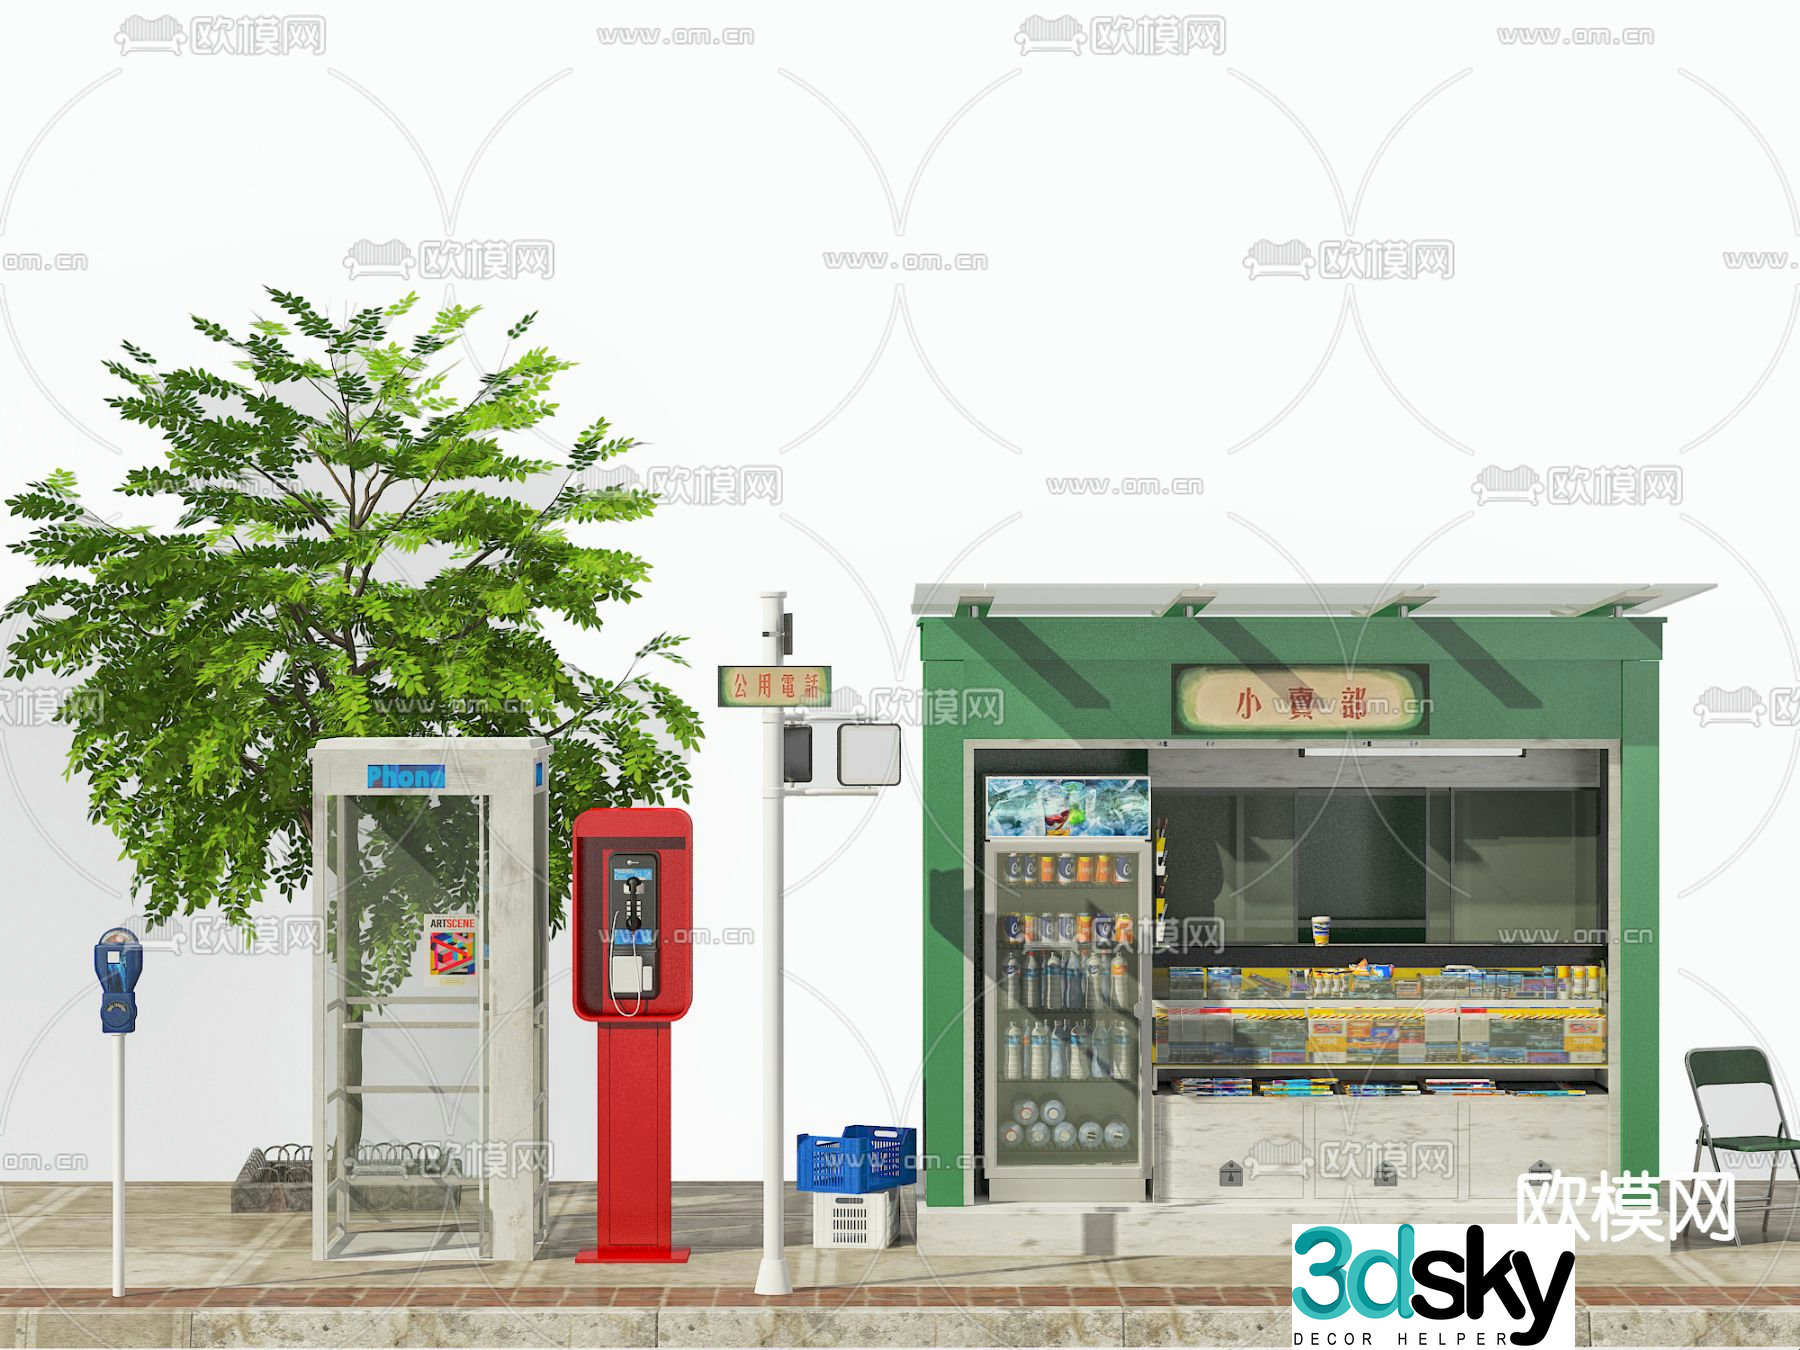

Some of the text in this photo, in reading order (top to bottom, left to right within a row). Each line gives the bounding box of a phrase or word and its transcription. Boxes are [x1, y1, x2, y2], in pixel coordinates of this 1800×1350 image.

[733, 672, 819, 698] 公用電話
[1235, 686, 1368, 720] 小賣部
